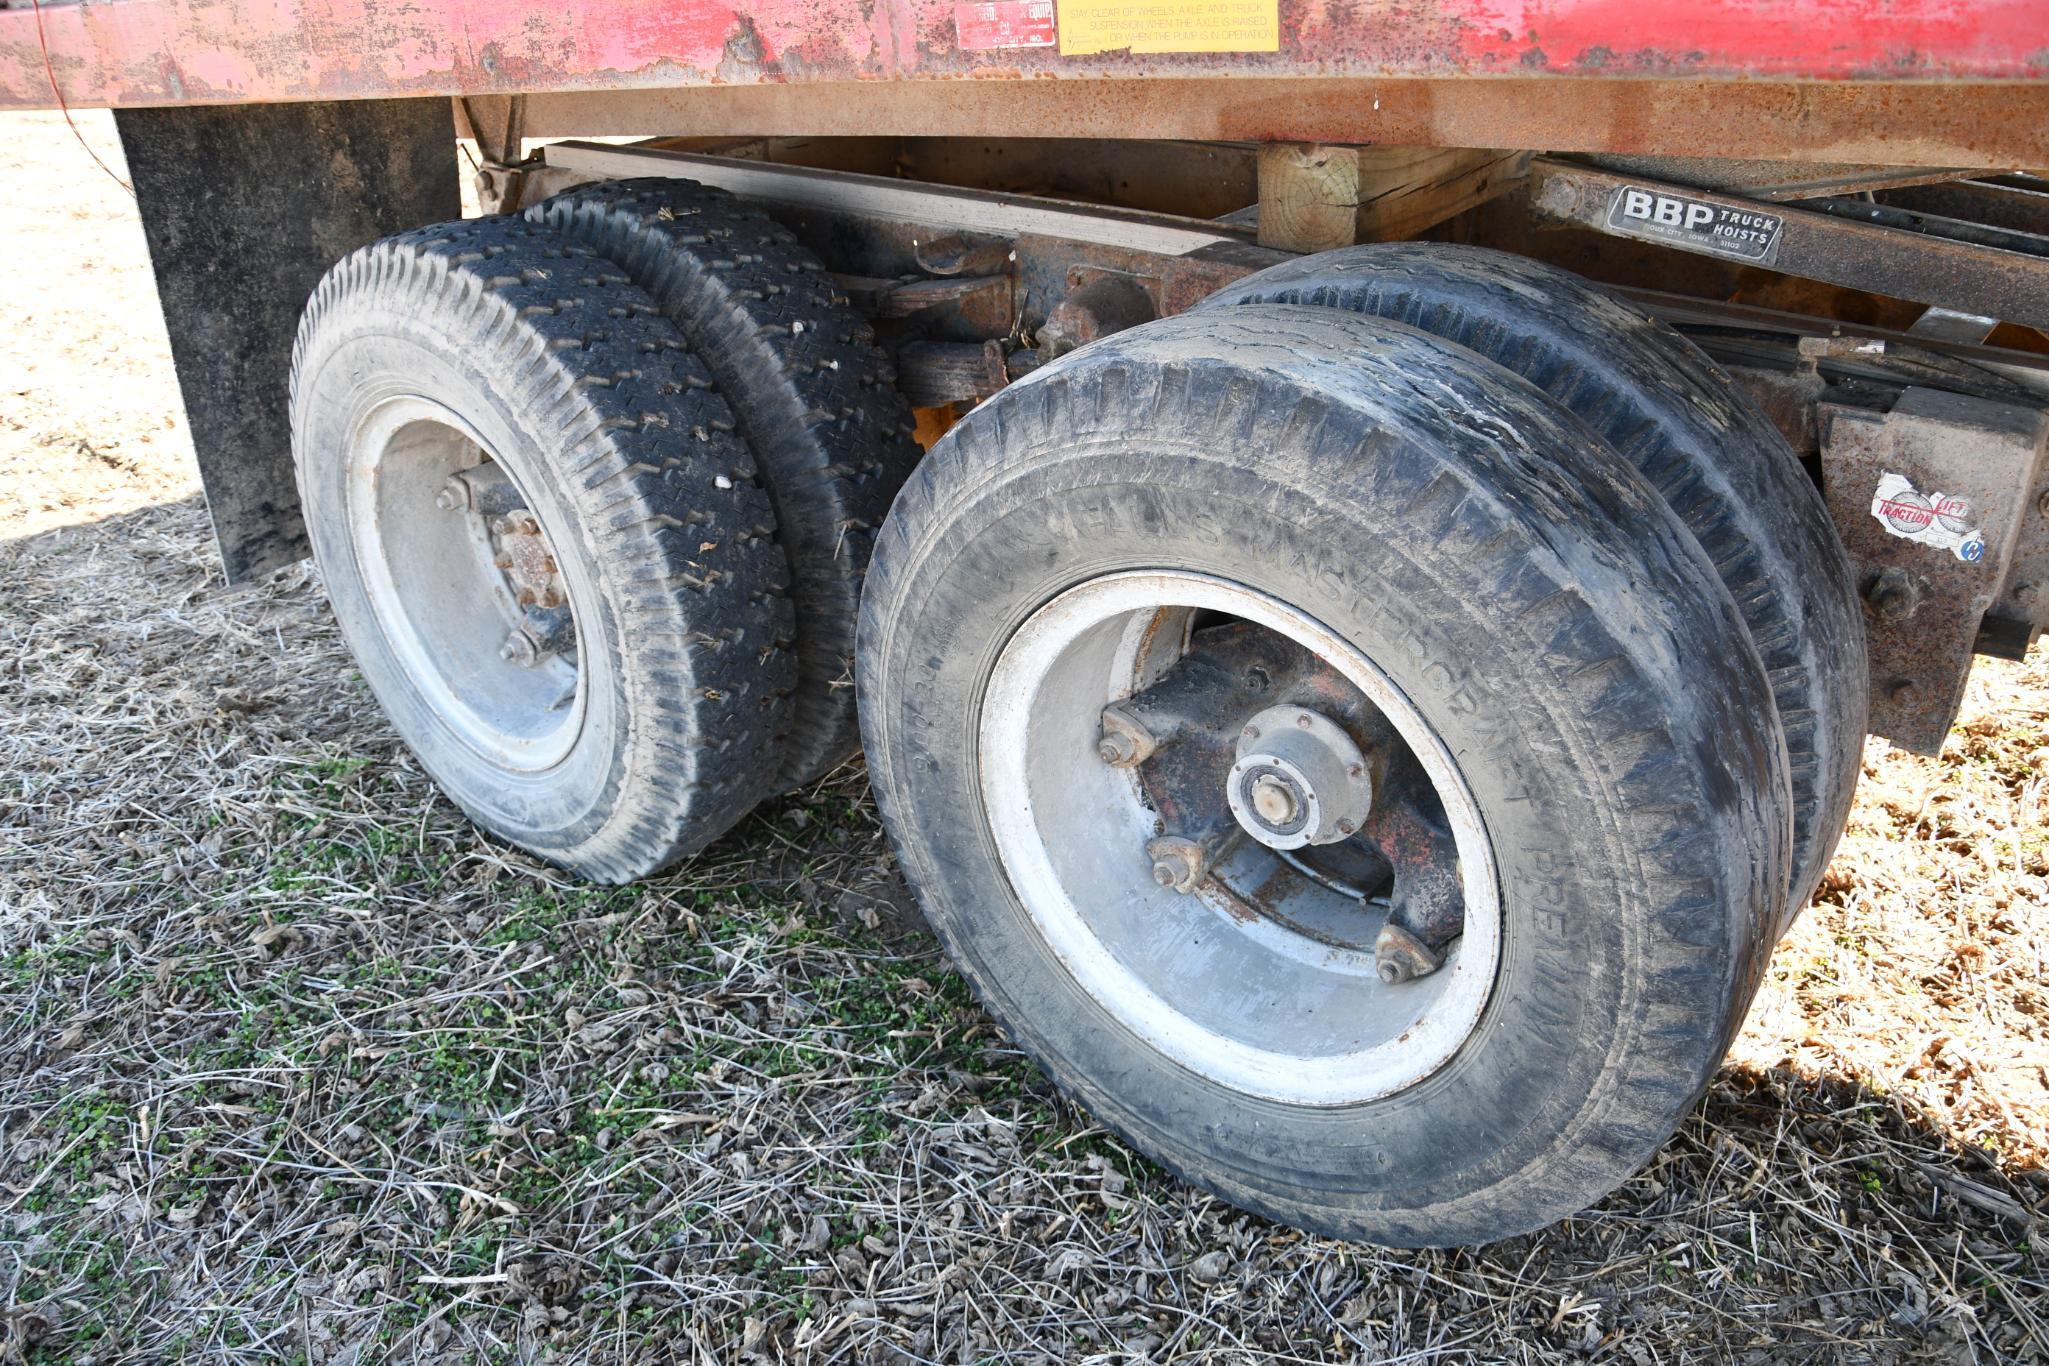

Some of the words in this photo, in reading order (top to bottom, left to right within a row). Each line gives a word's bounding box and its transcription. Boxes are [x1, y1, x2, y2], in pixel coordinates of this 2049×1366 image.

[1070, 8, 1089, 18] STAY
[1091, 7, 1120, 18] CLEAR
[1122, 7, 1136, 17] OF
[1179, 4, 1203, 16] AXLE
[1207, 4, 1229, 15] AND
[1231, 3, 1263, 14] TRUCK
[1089, 20, 1144, 31] SUSPENSION
[1145, 18, 1174, 29] WHEN
[1175, 18, 1193, 28] THE
[1196, 17, 1219, 27] AXLE
[1232, 15, 1268, 26] RAISED
[1109, 32, 1123, 42] OR
[1125, 31, 1152, 42] WHEN
[1154, 31, 1171, 41] THE
[1173, 30, 1198, 41] PUMP
[1221, 27, 1275, 40] OPERATION
[1623, 190, 1714, 230] BBP
[1720, 210, 1776, 231] TRUCK
[1713, 223, 1768, 244] HOISTS
[1878, 500, 1933, 526] TRACTION
[1934, 497, 1966, 514] LIFT
